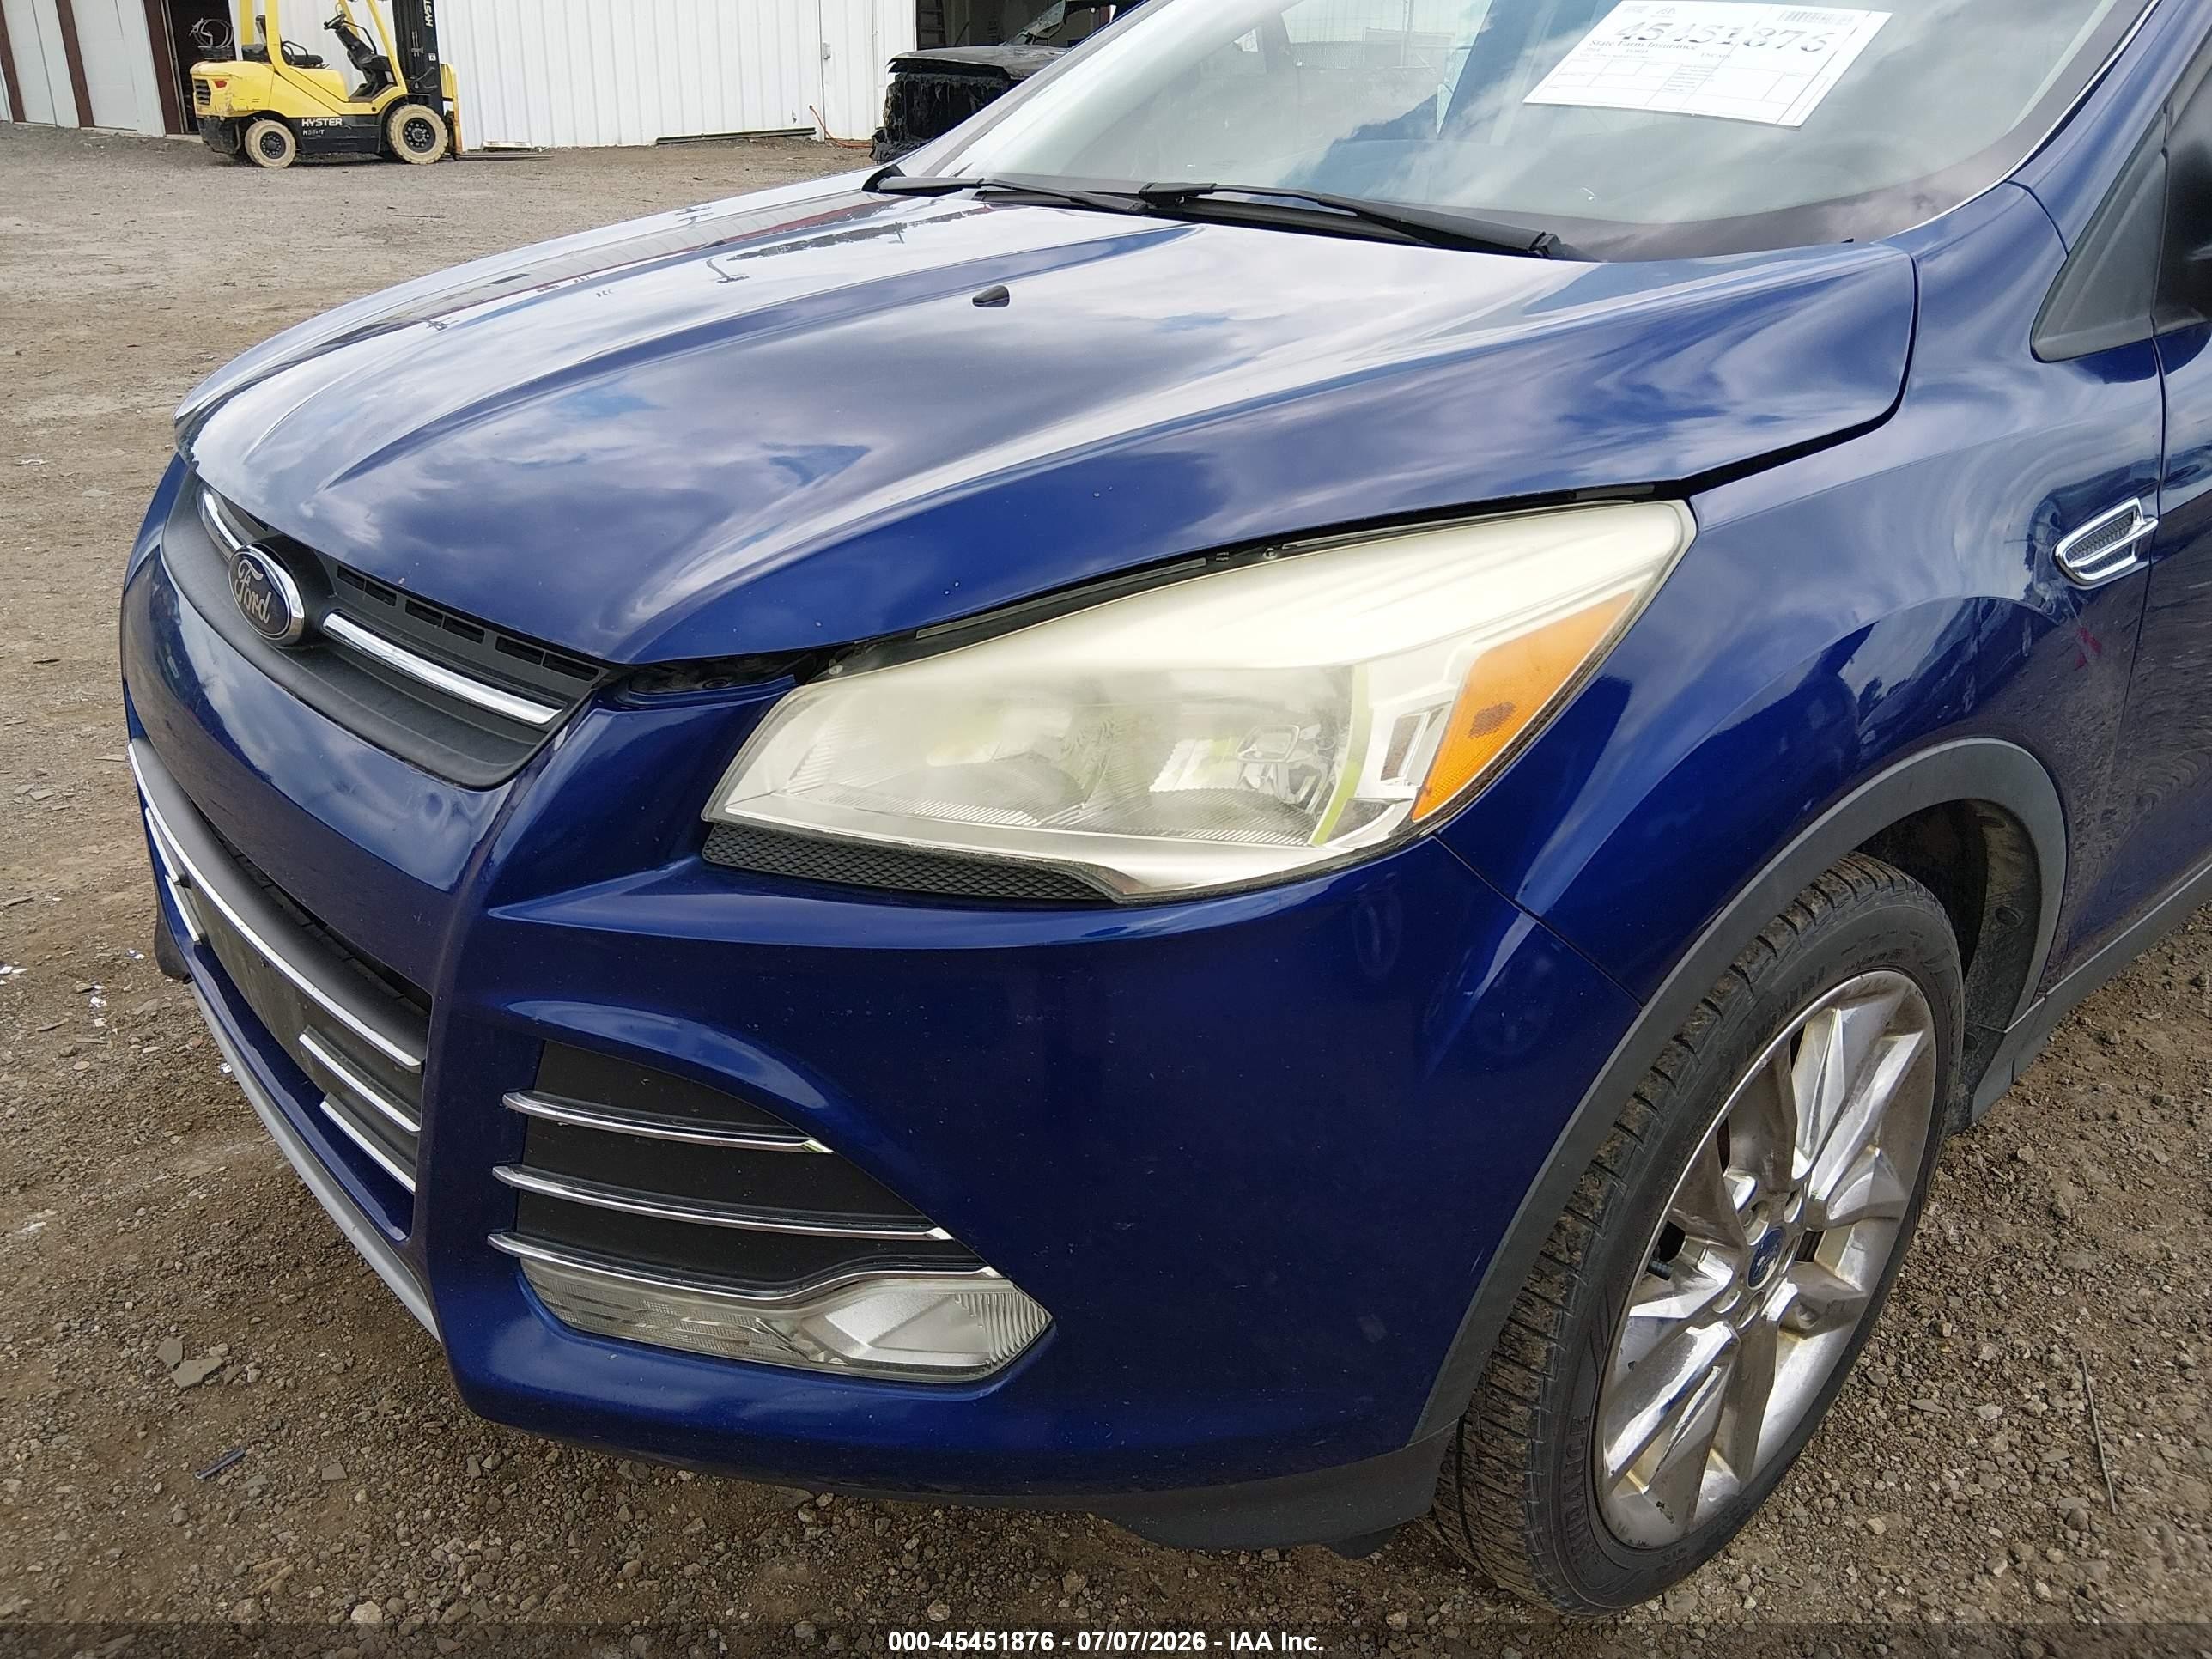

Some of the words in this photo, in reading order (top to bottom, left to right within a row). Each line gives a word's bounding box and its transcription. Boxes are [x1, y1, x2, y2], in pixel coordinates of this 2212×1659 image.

[1613, 21, 1837, 52] 45451876
[1647, 41, 1698, 51] Insurance
[301, 118, 343, 127] HYSTER
[234, 559, 272, 624] Ford
